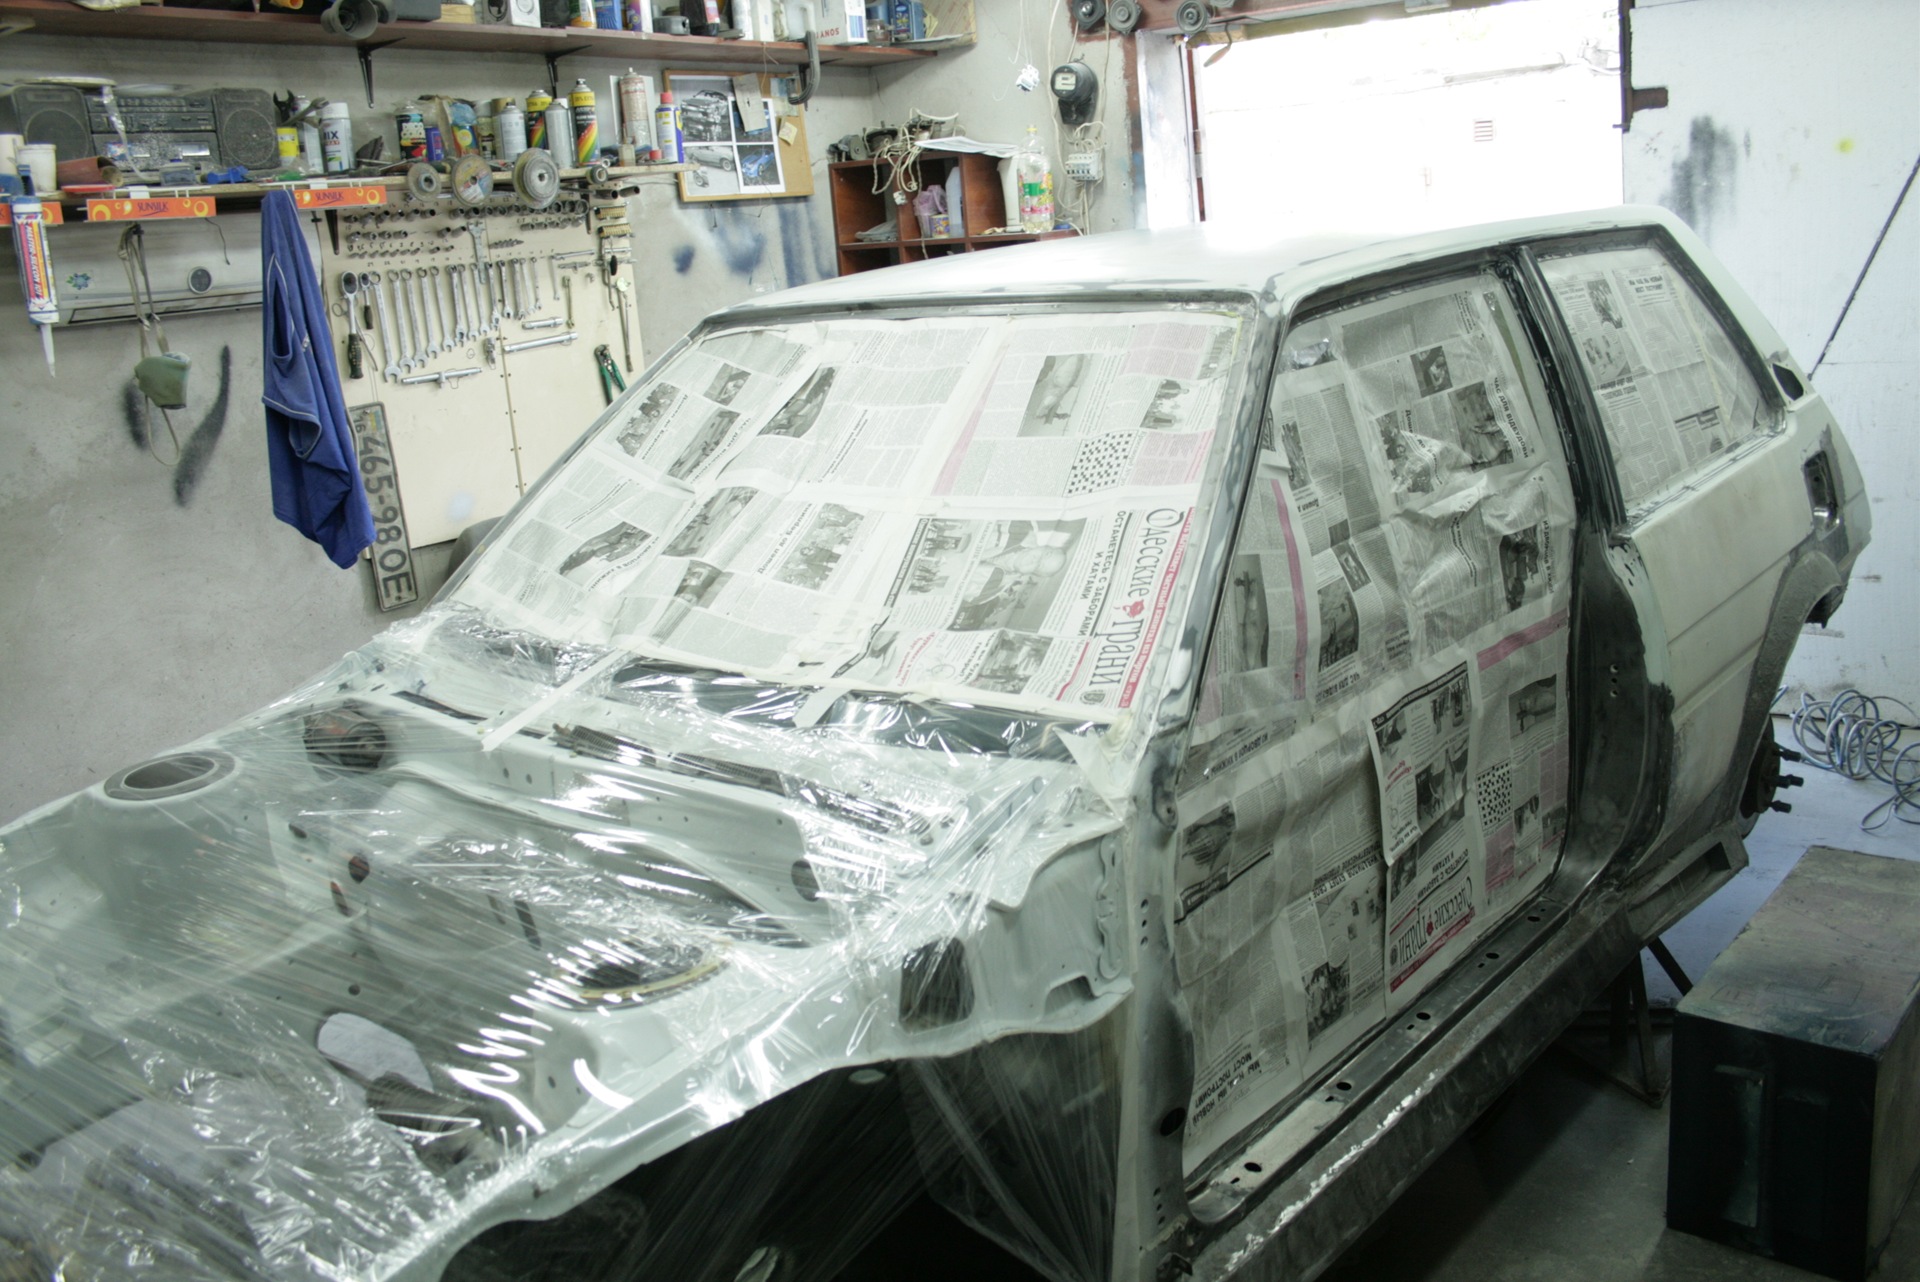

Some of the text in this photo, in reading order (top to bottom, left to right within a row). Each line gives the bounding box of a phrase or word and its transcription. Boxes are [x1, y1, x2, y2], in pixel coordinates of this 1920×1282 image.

[821, 27, 840, 38] SONY
[137, 201, 168, 212] SUNSILK
[315, 191, 344, 201] SUNSILK
[1104, 510, 1126, 574] ОСТАНЕТЕСЬ
[1127, 508, 1185, 598] Одесские
[1080, 560, 1100, 600] ХАТАМИ
[1078, 585, 1104, 637] ЗАБОРАМИ
[1233, 1051, 1253, 1073] МОСТ
[1247, 1060, 1260, 1074] МЫ
